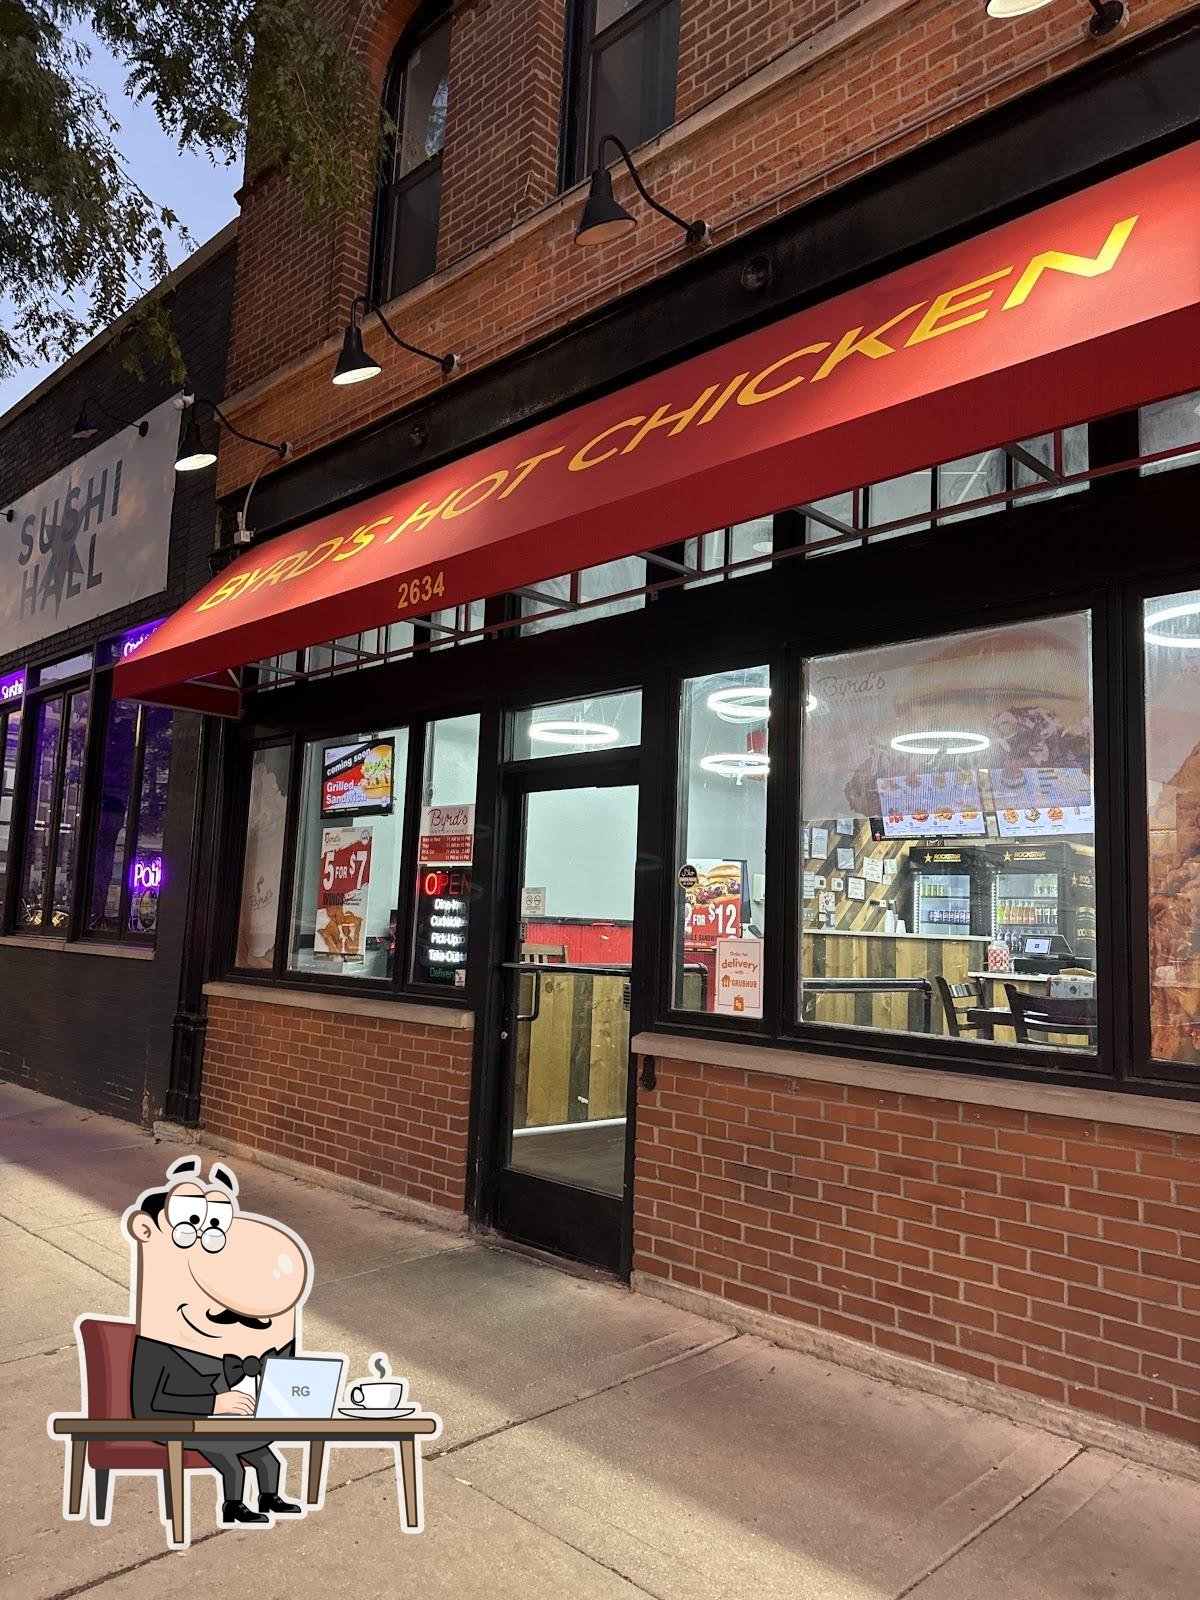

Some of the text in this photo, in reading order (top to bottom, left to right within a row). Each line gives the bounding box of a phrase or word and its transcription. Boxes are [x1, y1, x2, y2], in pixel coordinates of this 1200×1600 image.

[194, 214, 1139, 613] BYRD'S HOT CHICKEN
[18, 459, 123, 566] SUSHI
[20, 533, 103, 620] HALL
[397, 571, 445, 609] 2634
[326, 757, 353, 776] coming
[353, 747, 372, 763] soon
[326, 778, 354, 793] Grilled
[427, 808, 468, 831] Byrd's
[1013, 851, 1046, 859] ROCKSTAR
[323, 850, 368, 891] 5 FOR $7
[425, 873, 471, 895] OPEN
[693, 914, 706, 926] FOR
[708, 902, 737, 934] $12
[721, 958, 758, 973] delivery
[731, 979, 757, 988] GRUBHUB
